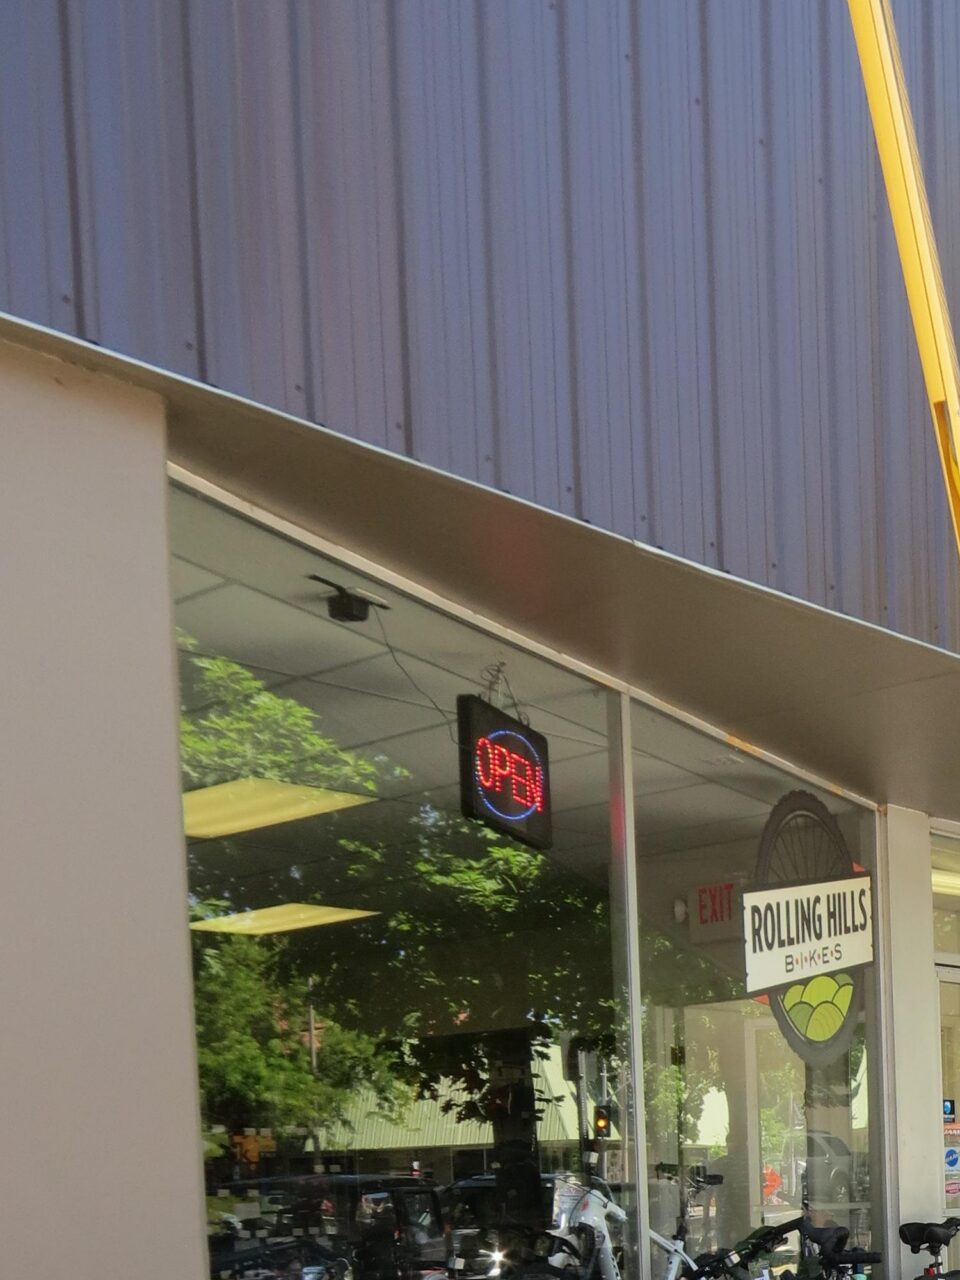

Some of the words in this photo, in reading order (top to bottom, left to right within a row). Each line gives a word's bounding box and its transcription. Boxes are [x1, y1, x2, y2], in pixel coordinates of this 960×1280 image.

[476, 736, 544, 813] OPEN
[698, 883, 734, 925] EXIT
[751, 895, 823, 954] ROLLING
[827, 888, 868, 938] HILLS
